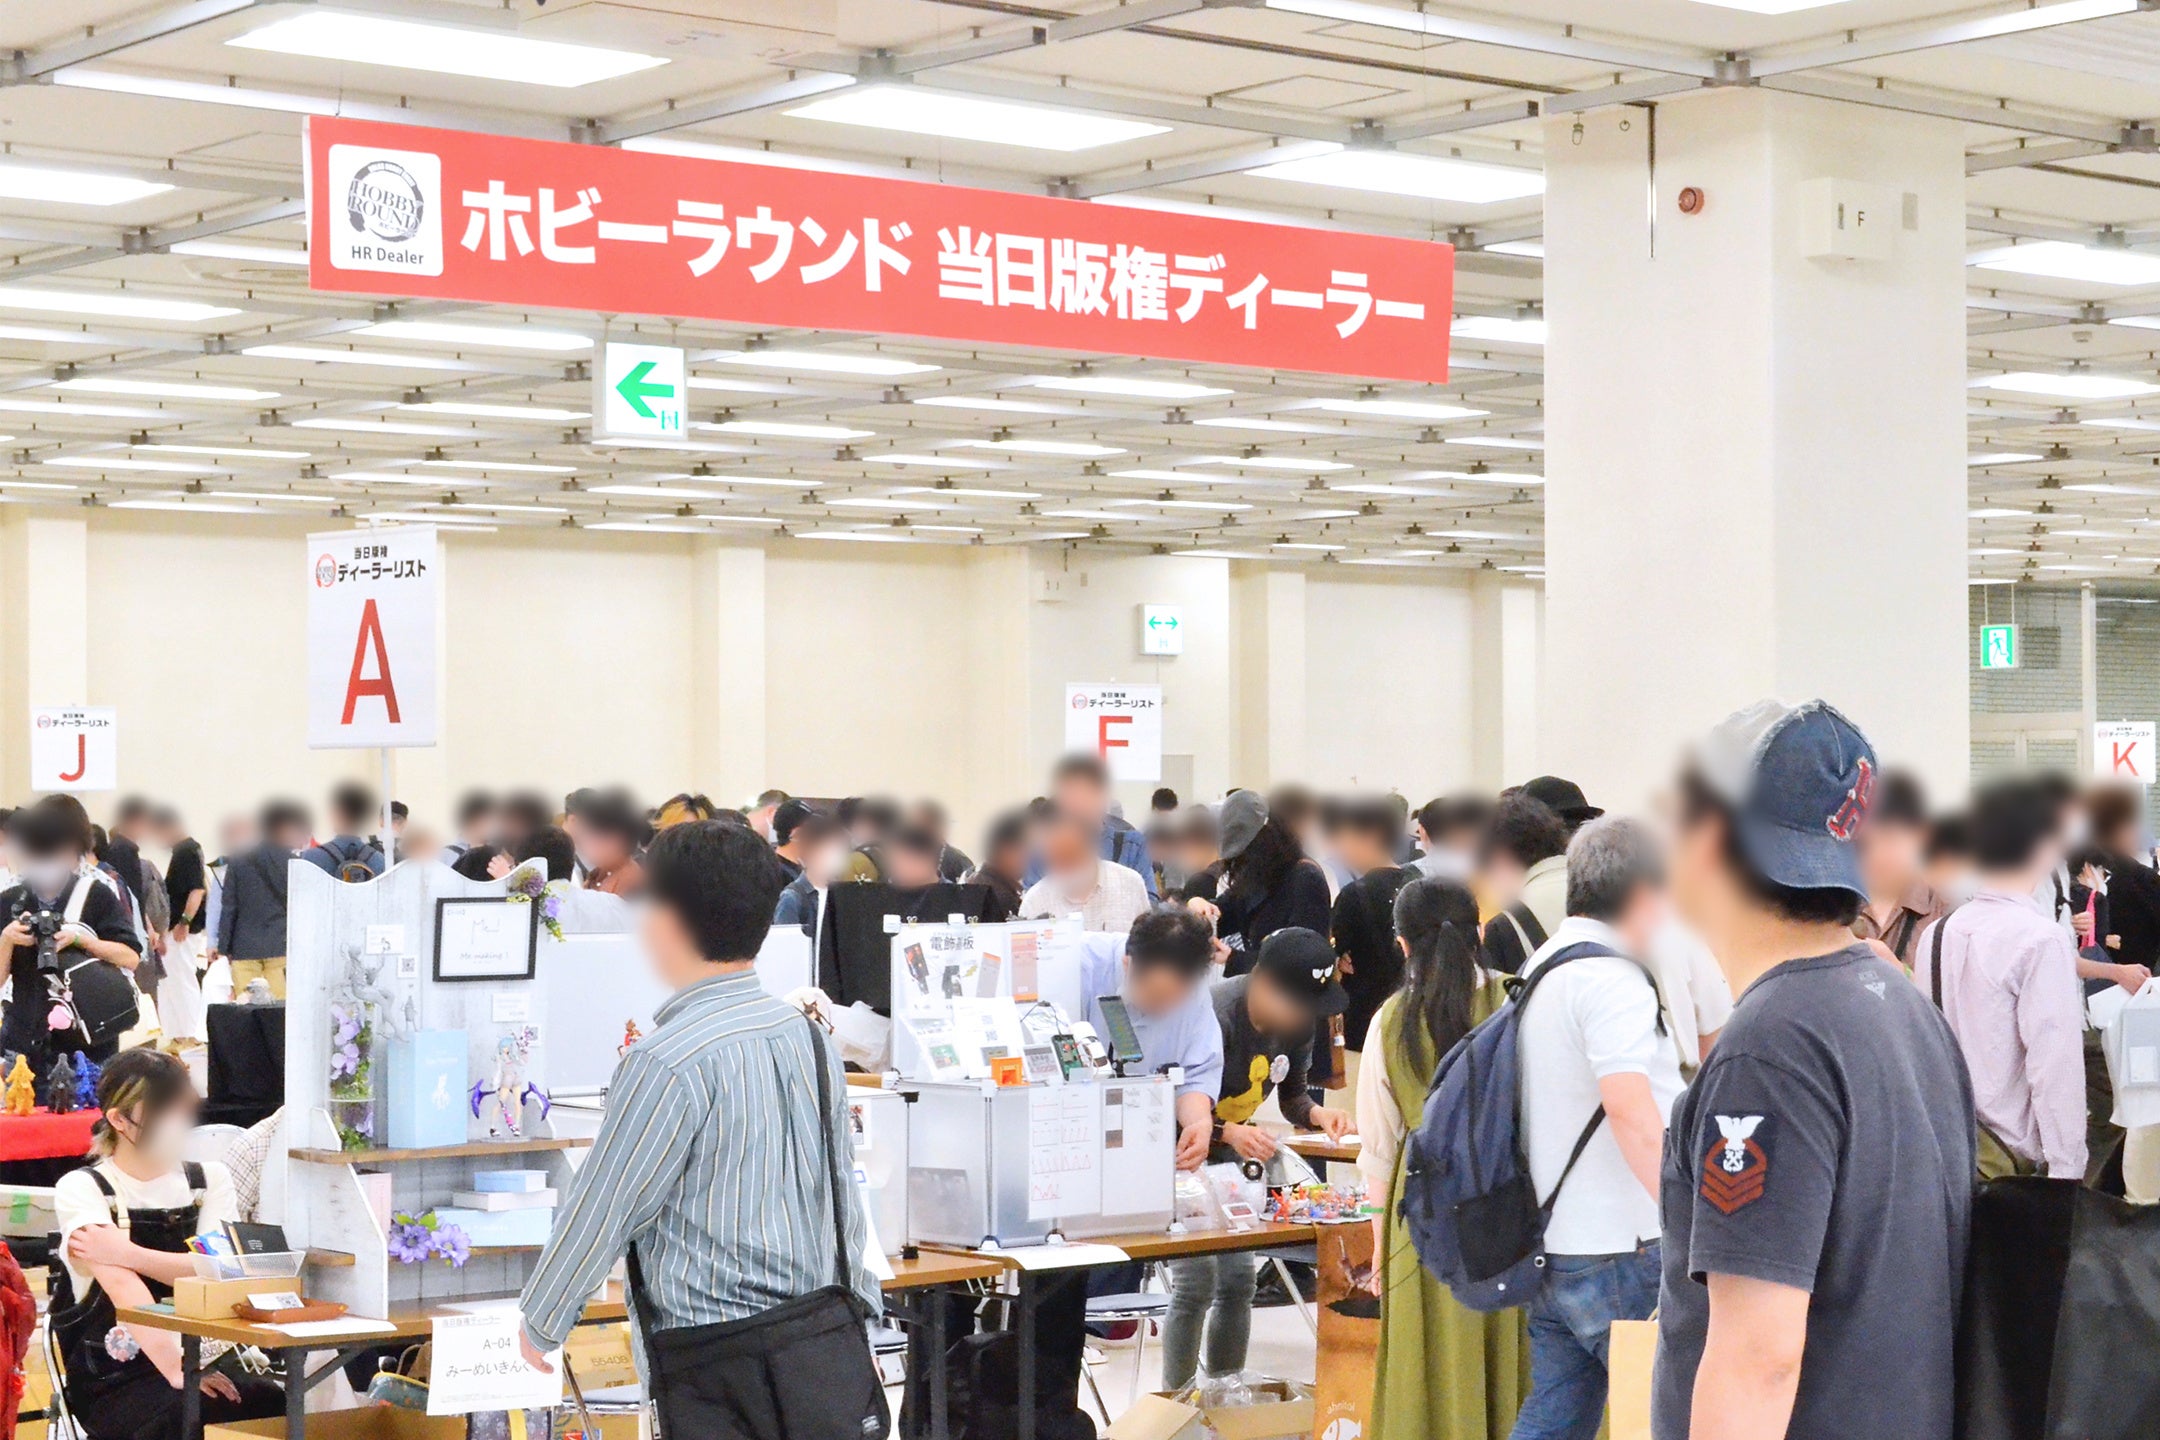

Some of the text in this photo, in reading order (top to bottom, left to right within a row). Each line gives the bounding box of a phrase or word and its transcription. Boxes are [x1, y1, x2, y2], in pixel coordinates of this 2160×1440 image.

[347, 194, 421, 231] ROUND
[350, 178, 418, 215] HOBBY
[351, 245, 424, 265] HR Dealer
[460, 180, 1425, 339] ホビーラウンド 当日版権ディーラー
[338, 559, 427, 582] ディーラーリスト
[340, 598, 402, 725] A
[1089, 699, 1154, 708] ディーラーリスト
[52, 719, 110, 728] ディーラーリスト
[1098, 715, 1133, 764] F
[58, 734, 86, 783] J
[2112, 741, 2140, 777] K
[483, 1336, 511, 1350] A-04
